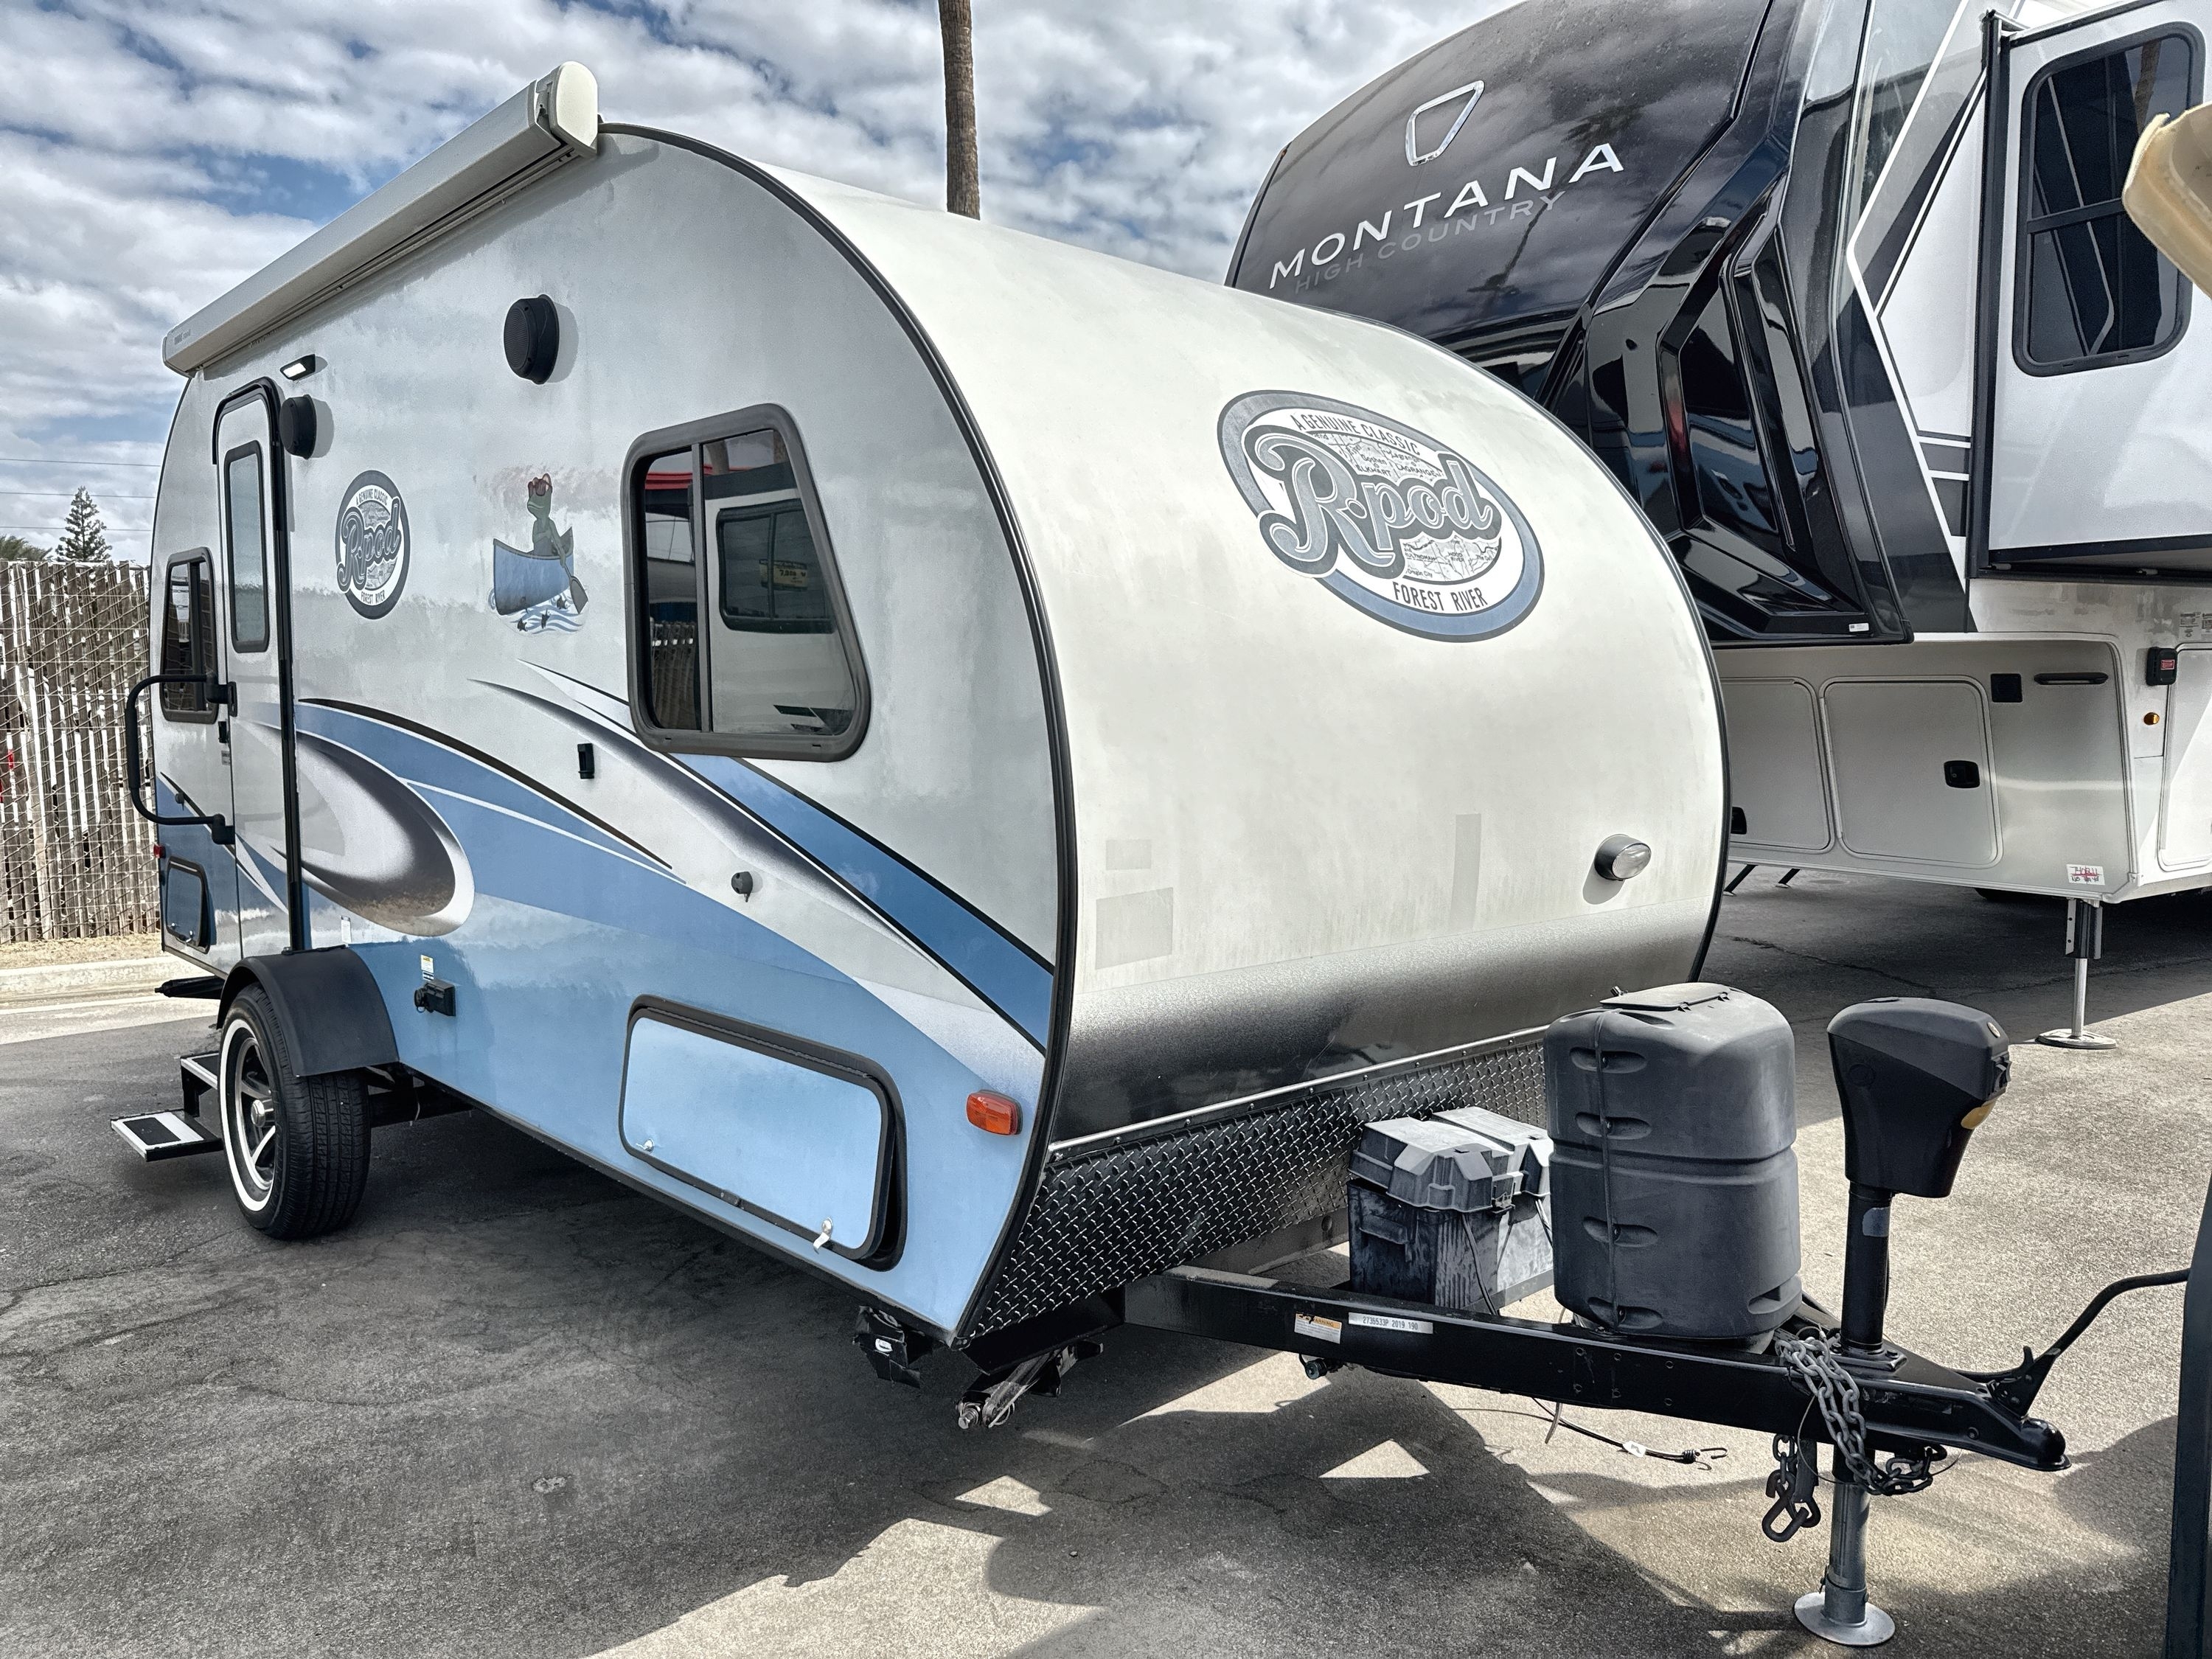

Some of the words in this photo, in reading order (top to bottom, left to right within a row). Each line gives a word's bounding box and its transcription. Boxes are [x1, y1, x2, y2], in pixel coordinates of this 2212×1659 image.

[1270, 142, 1624, 289] MONTANA
[1295, 252, 1364, 294] HIGH
[1377, 190, 1566, 260] COUNTRY
[1290, 415, 1306, 431] A
[1301, 414, 1361, 434] GENUINE
[1360, 423, 1421, 456] CLASSIC
[1356, 465, 1391, 476] ELKHART
[1361, 453, 1388, 465] Goshen
[1393, 581, 1444, 611] FOREST
[1450, 587, 1488, 611] RIVER
[1391, 1320, 1405, 1329] 2019
[1408, 1322, 1419, 1330] 190
